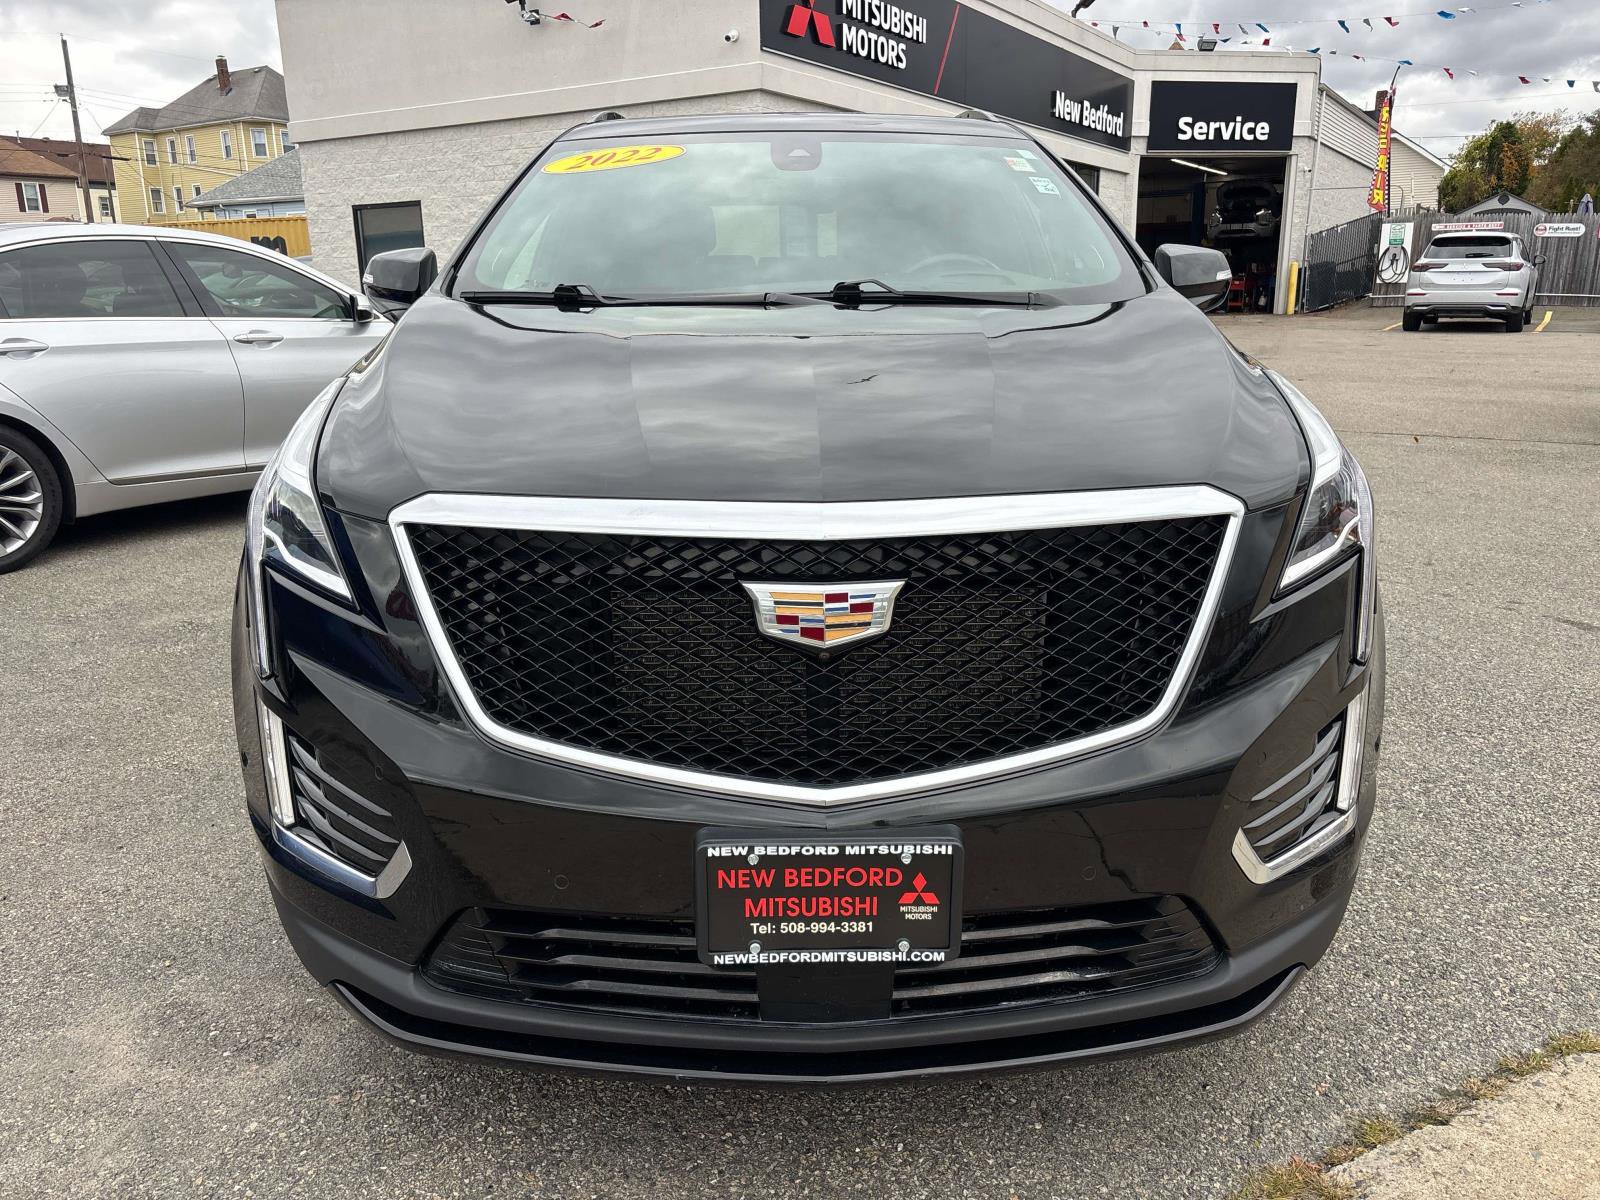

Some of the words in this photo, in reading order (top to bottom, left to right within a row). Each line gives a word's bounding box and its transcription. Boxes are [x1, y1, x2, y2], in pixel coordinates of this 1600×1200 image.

[842, 0, 927, 43] MITSUBISHI
[842, 23, 907, 69] MOTORS
[1055, 90, 1081, 124] New
[1082, 100, 1124, 137] Bedford
[1177, 115, 1270, 141] Service
[565, 147, 662, 170] 2022
[707, 847, 748, 857] NEW
[754, 846, 840, 856] BEDFORD
[845, 845, 953, 855] MITSUBISHI
[717, 868, 776, 889] NEW
[784, 866, 903, 888] BEDFORD
[744, 896, 878, 918] MITSUBISHI
[750, 922, 776, 935] Tel:
[780, 921, 873, 934] 508-994-3381
[713, 951, 945, 965] NEWBEDFORDMITSUBISHI.COM
